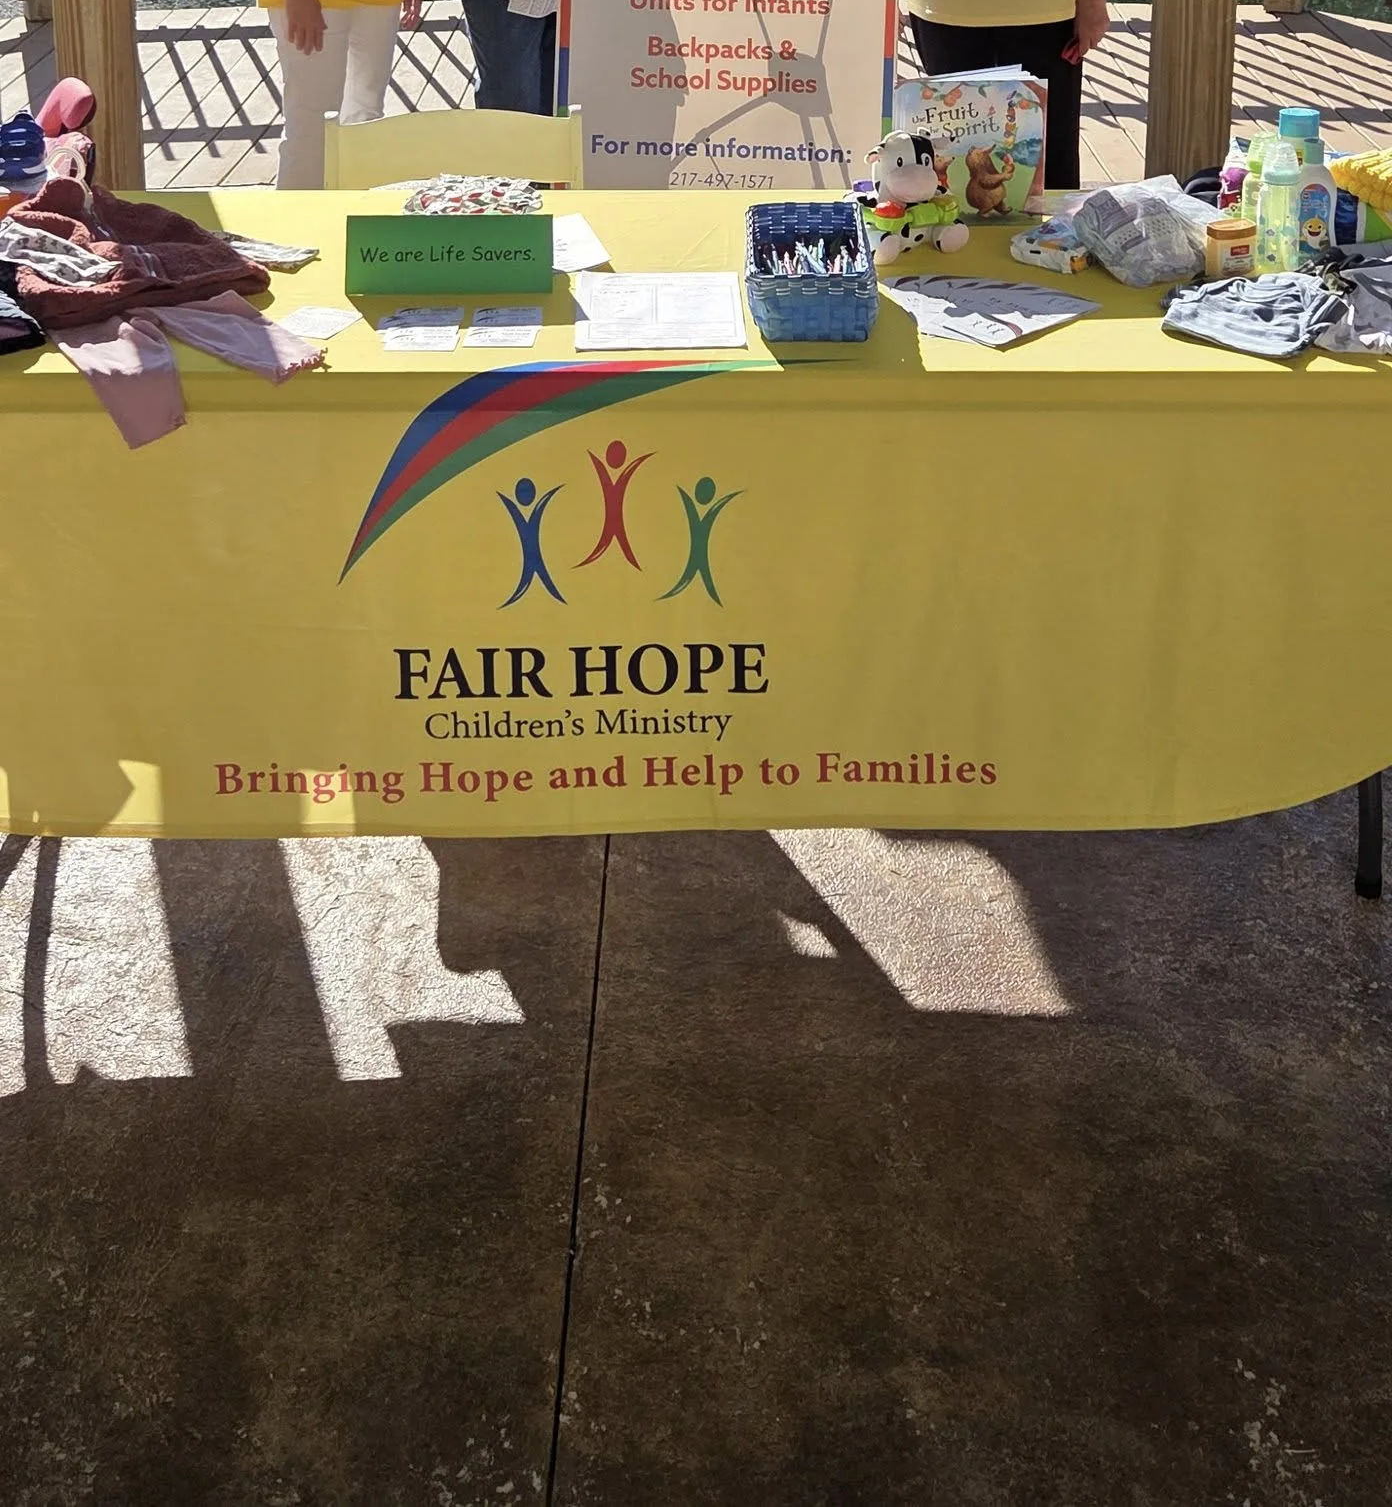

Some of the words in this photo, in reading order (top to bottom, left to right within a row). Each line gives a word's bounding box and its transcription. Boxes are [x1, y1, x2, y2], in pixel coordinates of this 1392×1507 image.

[647, 36, 773, 63] Backpacks
[779, 40, 797, 61] &
[631, 67, 711, 91] School
[717, 69, 818, 97] Supplies
[925, 102, 979, 124] Fruit
[942, 116, 1000, 143] Spirit
[591, 135, 630, 155] For
[636, 140, 697, 157] more
[705, 138, 852, 163] information:
[669, 172, 774, 189] 217-497-1571
[359, 246, 389, 264] We
[395, 249, 425, 262] are
[430, 245, 466, 262] Life
[472, 245, 536, 262] Savers.
[393, 647, 554, 700] FAIR
[570, 643, 770, 698] HOPE
[424, 709, 585, 740] Children's
[594, 707, 733, 741] Ministry
[213, 762, 404, 802] Bringing
[420, 759, 534, 802] Hope
[548, 754, 627, 789] and
[642, 754, 745, 795] Help
[759, 758, 800, 787] to
[816, 750, 998, 787] Families
